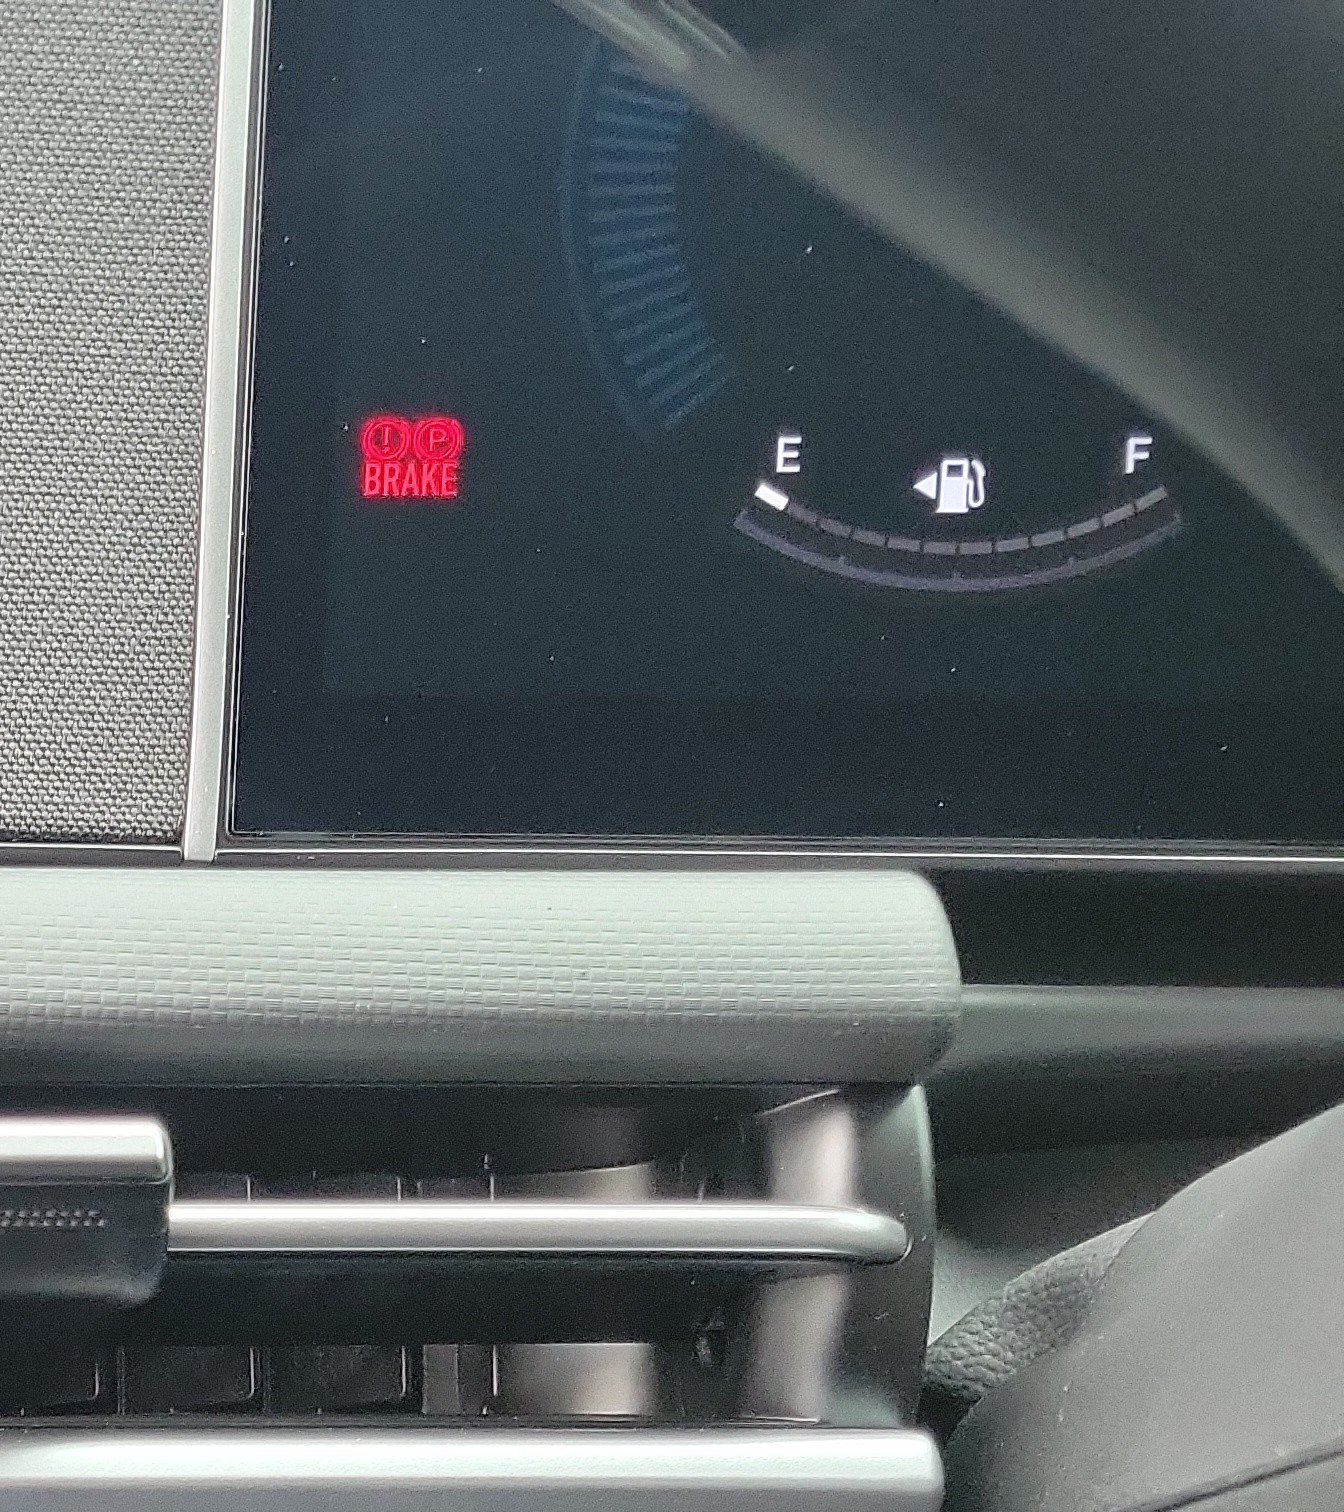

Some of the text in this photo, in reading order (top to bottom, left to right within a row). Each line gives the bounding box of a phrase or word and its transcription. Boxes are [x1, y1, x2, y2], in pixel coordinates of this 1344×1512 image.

[776, 435, 802, 473] E
[1124, 436, 1153, 475] F
[363, 461, 458, 497] BRAKE
